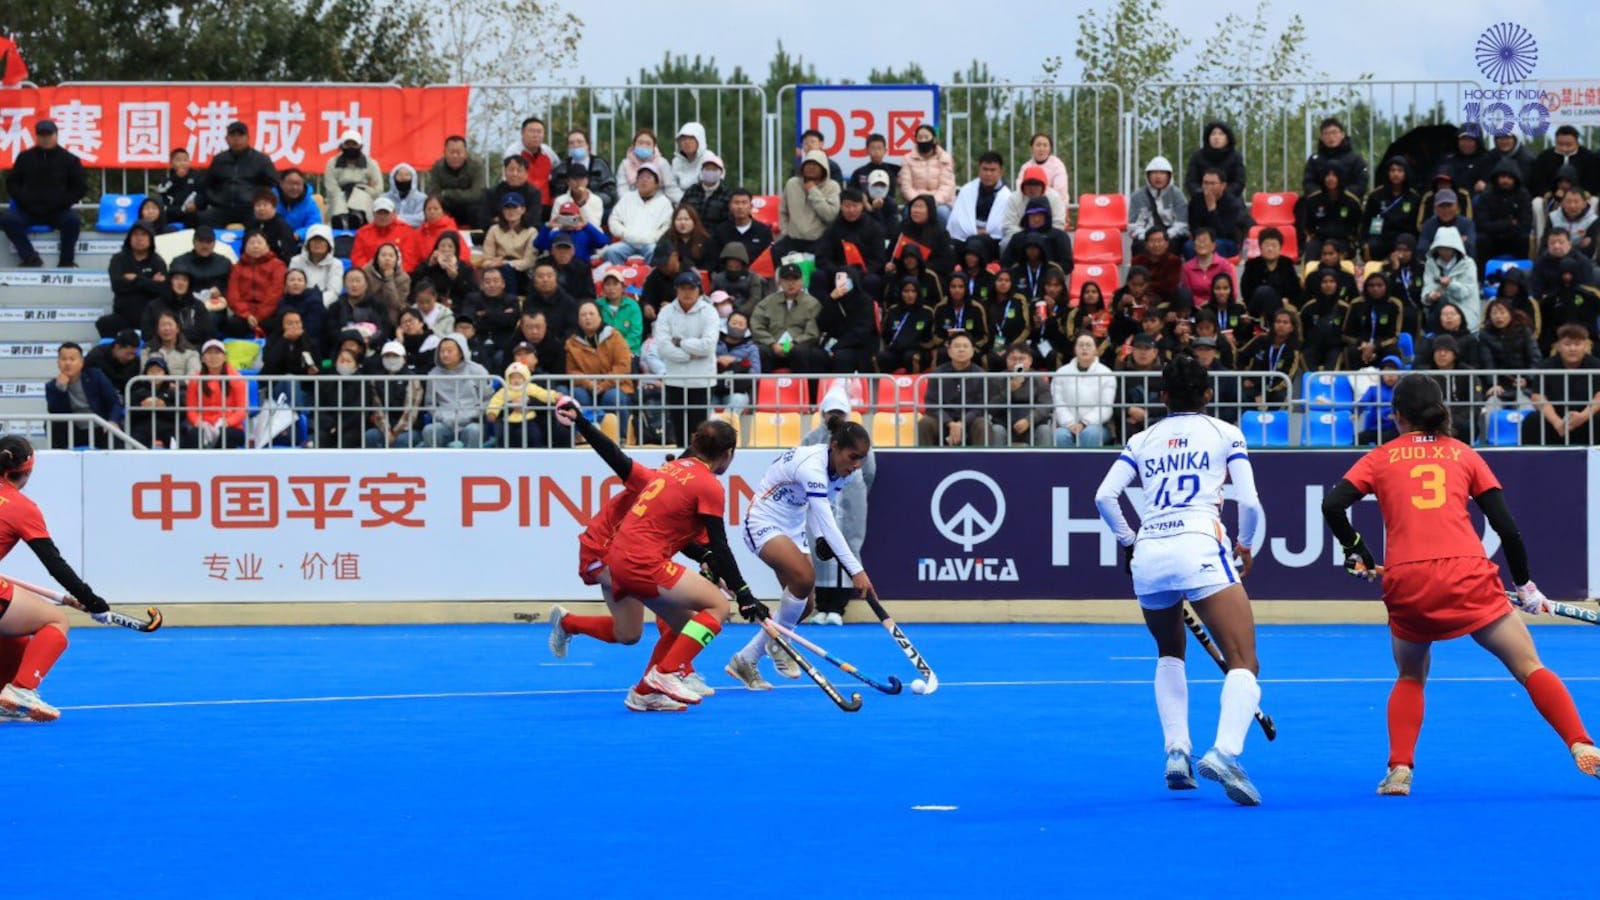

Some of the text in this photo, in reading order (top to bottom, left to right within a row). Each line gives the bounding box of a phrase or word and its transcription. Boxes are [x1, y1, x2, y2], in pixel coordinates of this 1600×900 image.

[810, 108, 925, 157] D3区
[1168, 439, 1188, 448] FIH
[1388, 446, 1462, 464] ZUO.X.Y
[1145, 451, 1210, 478] SANIKA
[132, 473, 426, 531] 中国平安
[631, 478, 665, 516] 2
[1154, 474, 1200, 510] 42
[1410, 464, 1447, 510] 3
